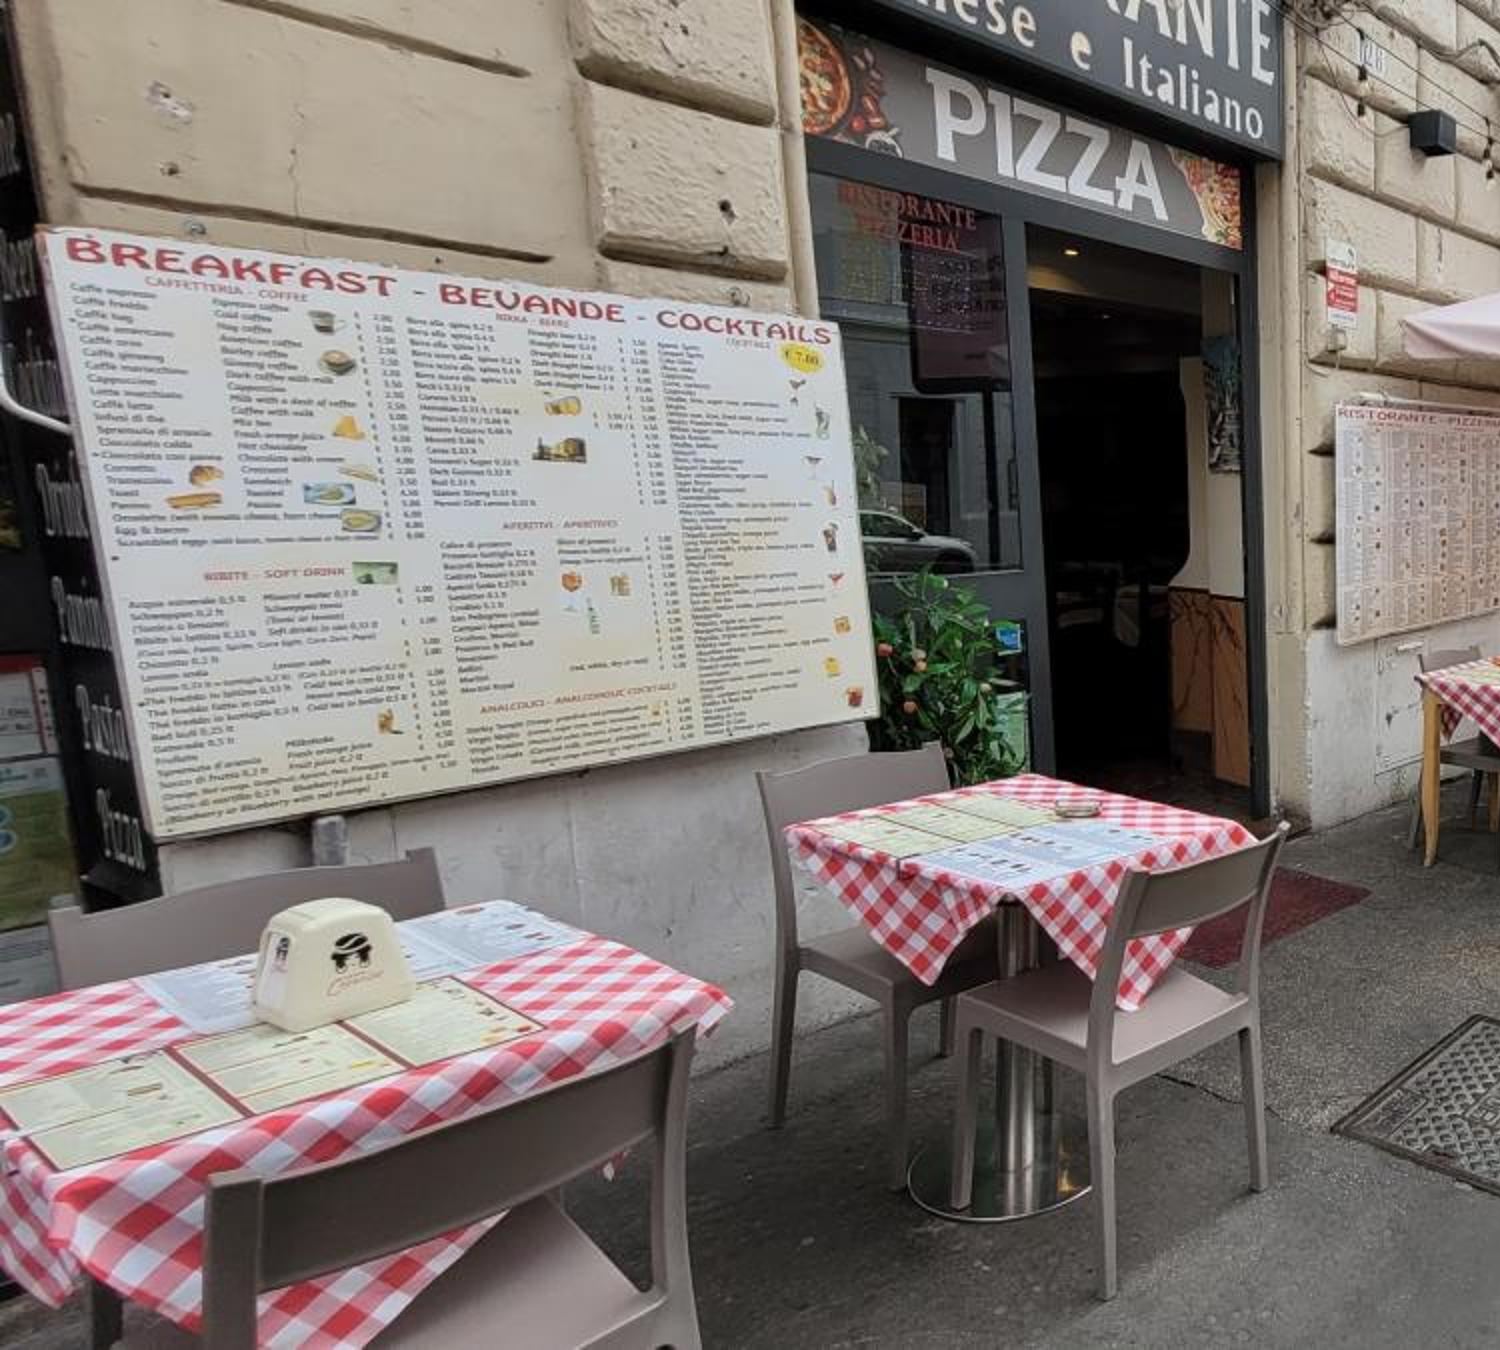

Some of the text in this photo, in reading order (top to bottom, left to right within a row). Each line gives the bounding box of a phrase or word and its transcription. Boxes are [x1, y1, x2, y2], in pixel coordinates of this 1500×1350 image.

[1070, 31, 1092, 70] e
[1123, 36, 1263, 139] Italiano
[925, 66, 1169, 222] PIZZA
[65, 237, 397, 296] BREAKFAST
[439, 283, 625, 323] BEVANDE
[656, 310, 831, 345] COCKTAILS
[1337, 407, 1438, 425] RISTORANTE
